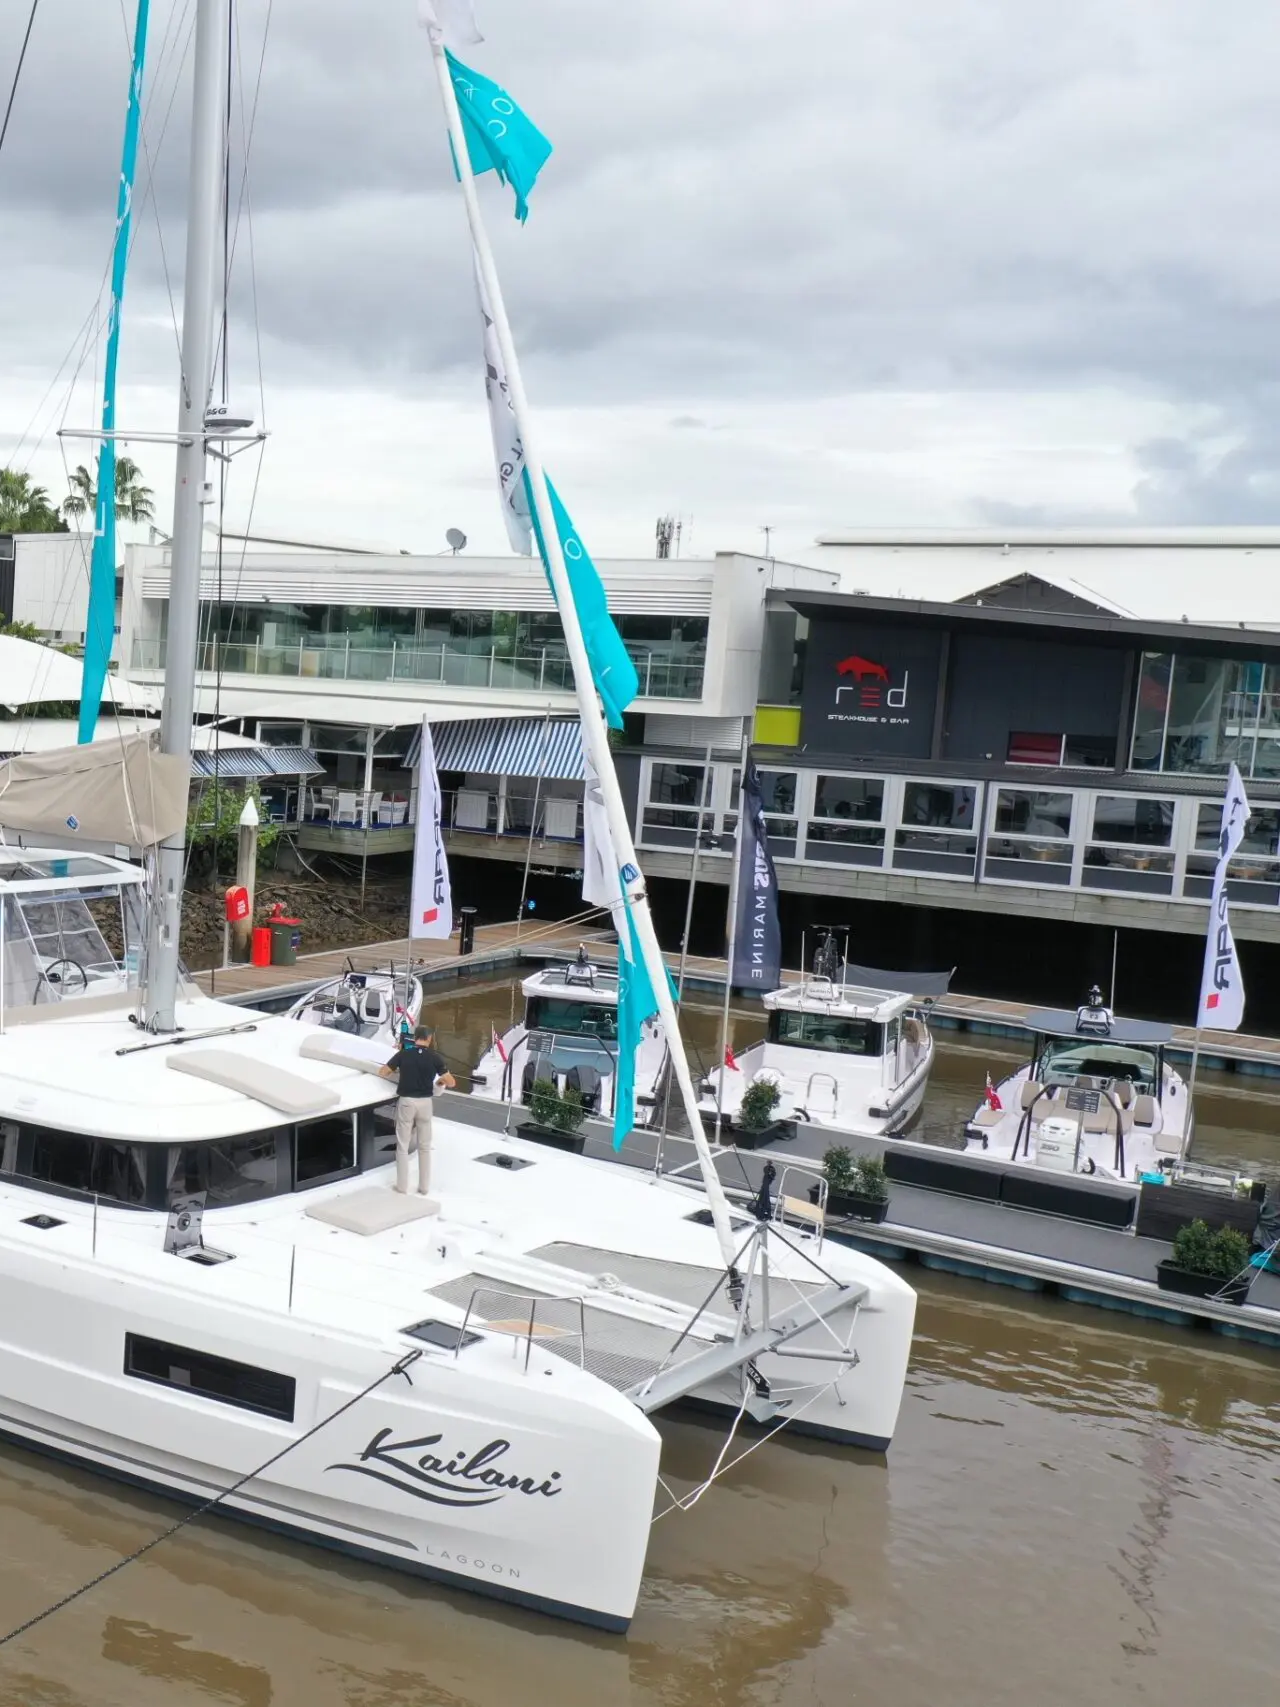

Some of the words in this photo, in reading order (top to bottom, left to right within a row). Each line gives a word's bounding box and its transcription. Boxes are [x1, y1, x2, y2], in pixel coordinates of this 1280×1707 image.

[827, 714, 878, 723] STEAKHOUSE
[747, 1367, 761, 1385] ELTA
[352, 1427, 564, 1498] Kailani
[425, 1545, 521, 1579] LAGOON
